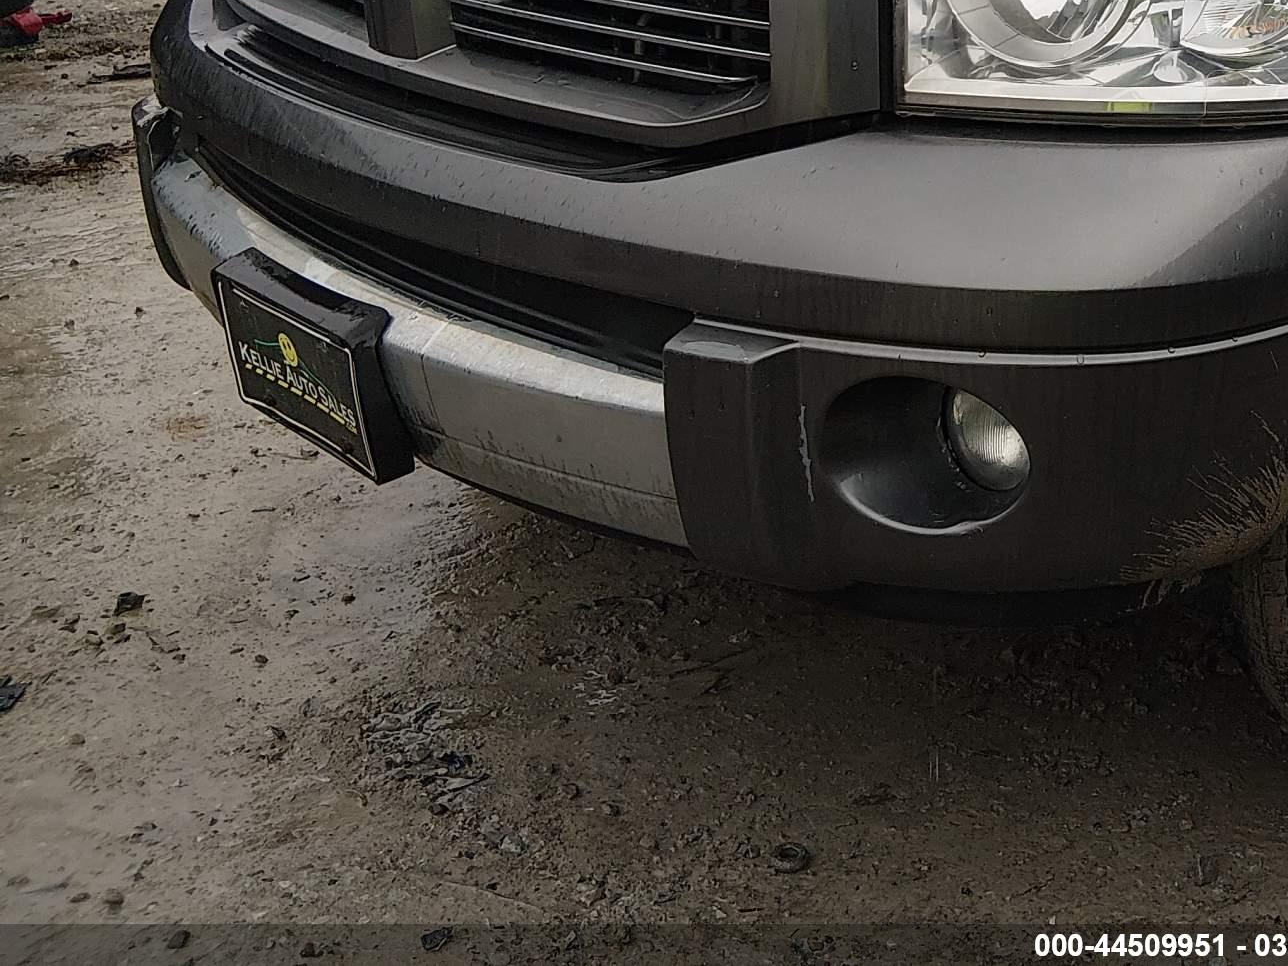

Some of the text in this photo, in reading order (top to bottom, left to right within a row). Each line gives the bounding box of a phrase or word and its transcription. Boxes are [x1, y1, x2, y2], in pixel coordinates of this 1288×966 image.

[238, 341, 357, 427] KELLIE AUTO SALES
